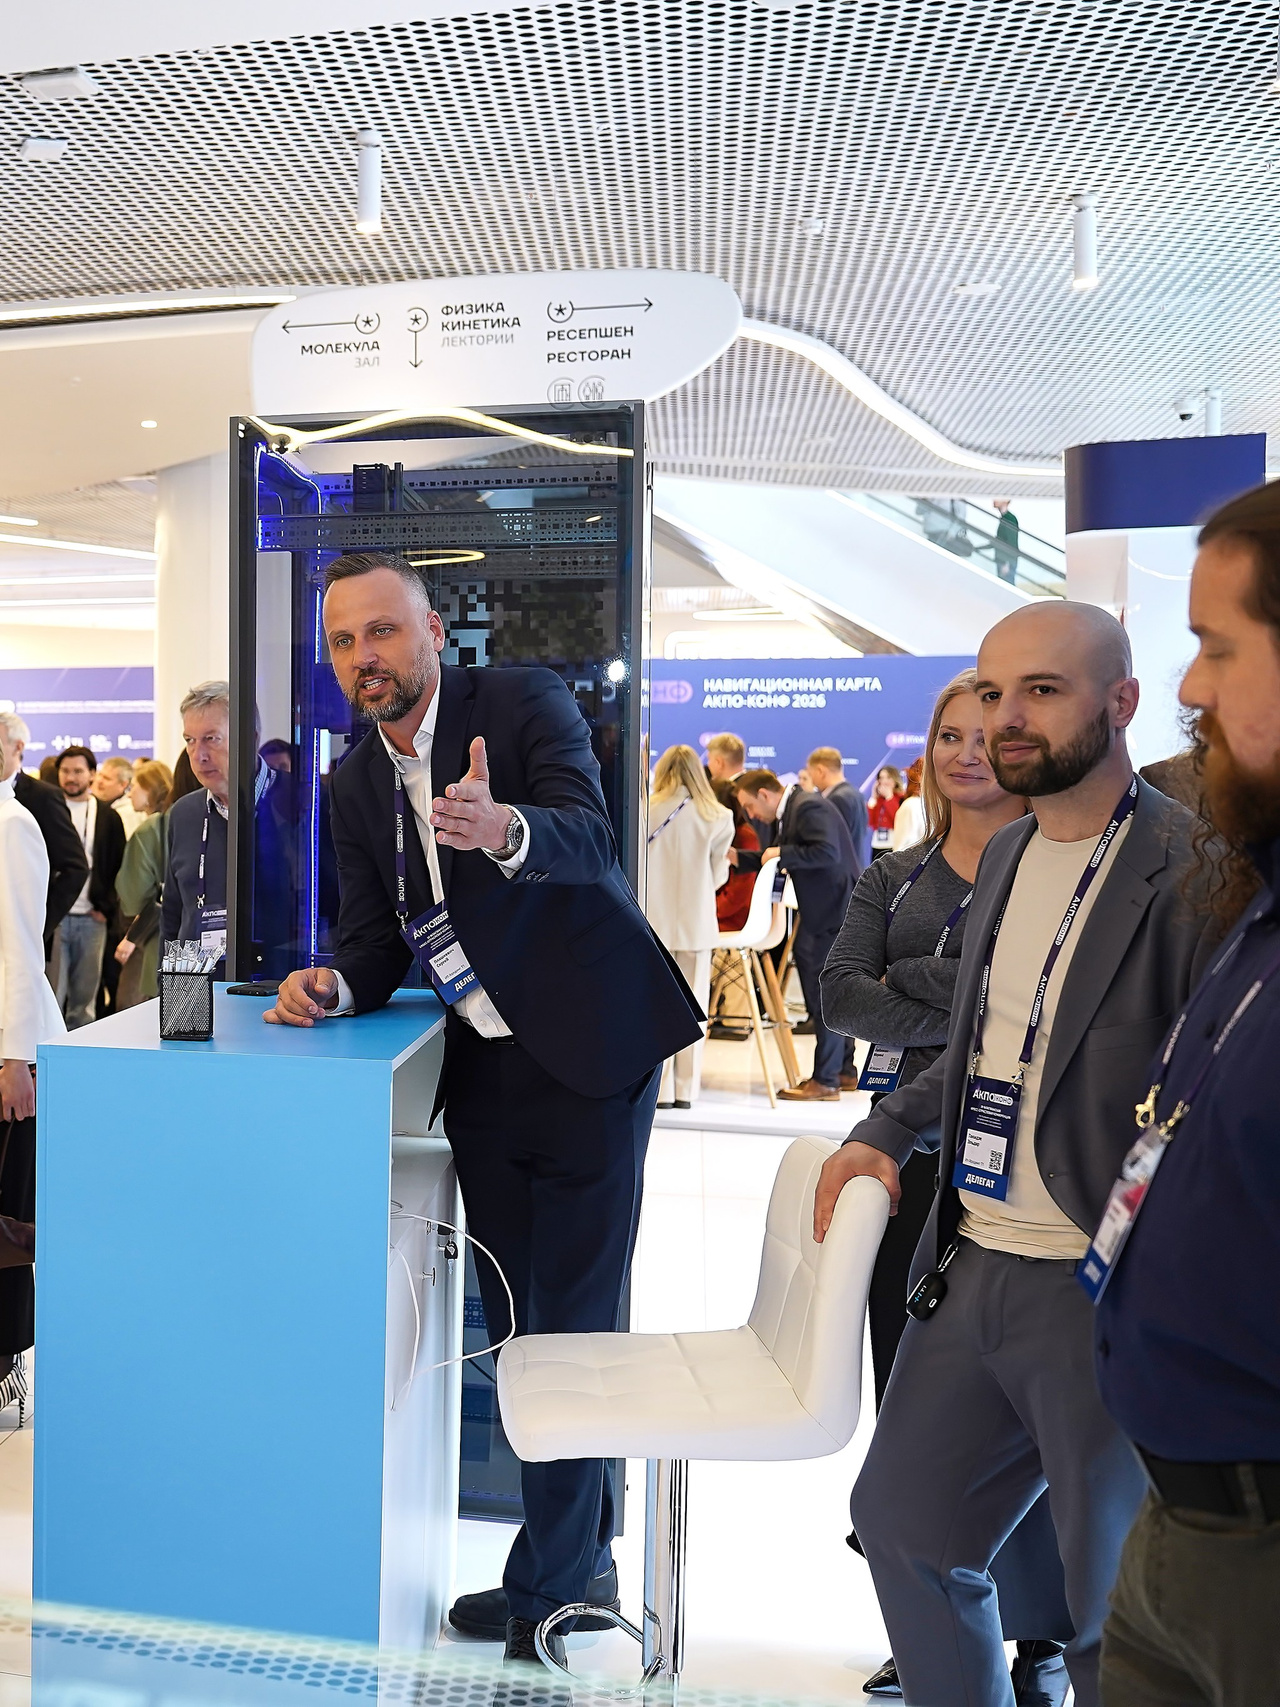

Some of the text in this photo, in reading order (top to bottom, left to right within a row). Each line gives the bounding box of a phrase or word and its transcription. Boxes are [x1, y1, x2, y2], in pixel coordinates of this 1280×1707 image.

[441, 302, 505, 316] ФИЗИКА
[441, 316, 521, 332] КИНЕТИКА
[440, 333, 515, 348] ЛЕКТОРИИ
[546, 325, 635, 342] РЕСЕПШЕН
[300, 341, 381, 356] МОЛЕКУЛА
[546, 348, 632, 364] РЕСТОРАН
[354, 356, 380, 369] ЗАЛ
[703, 677, 883, 693] НАВИГАЦИОННАЯ КАРТА
[702, 694, 827, 708] АКПО-КОНФ 2026
[1090, 819, 1119, 868] АКПОКОНФ
[413, 910, 450, 940] АКПОКОН
[1054, 895, 1081, 946] АКПОКОНФ
[454, 972, 476, 993] ДЕЛЕГ
[1030, 974, 1048, 1027] АКПОКОНФ
[866, 1076, 890, 1086] ДЕЛЕГАТ
[965, 1173, 996, 1190] ДЕЛЕГАТ
